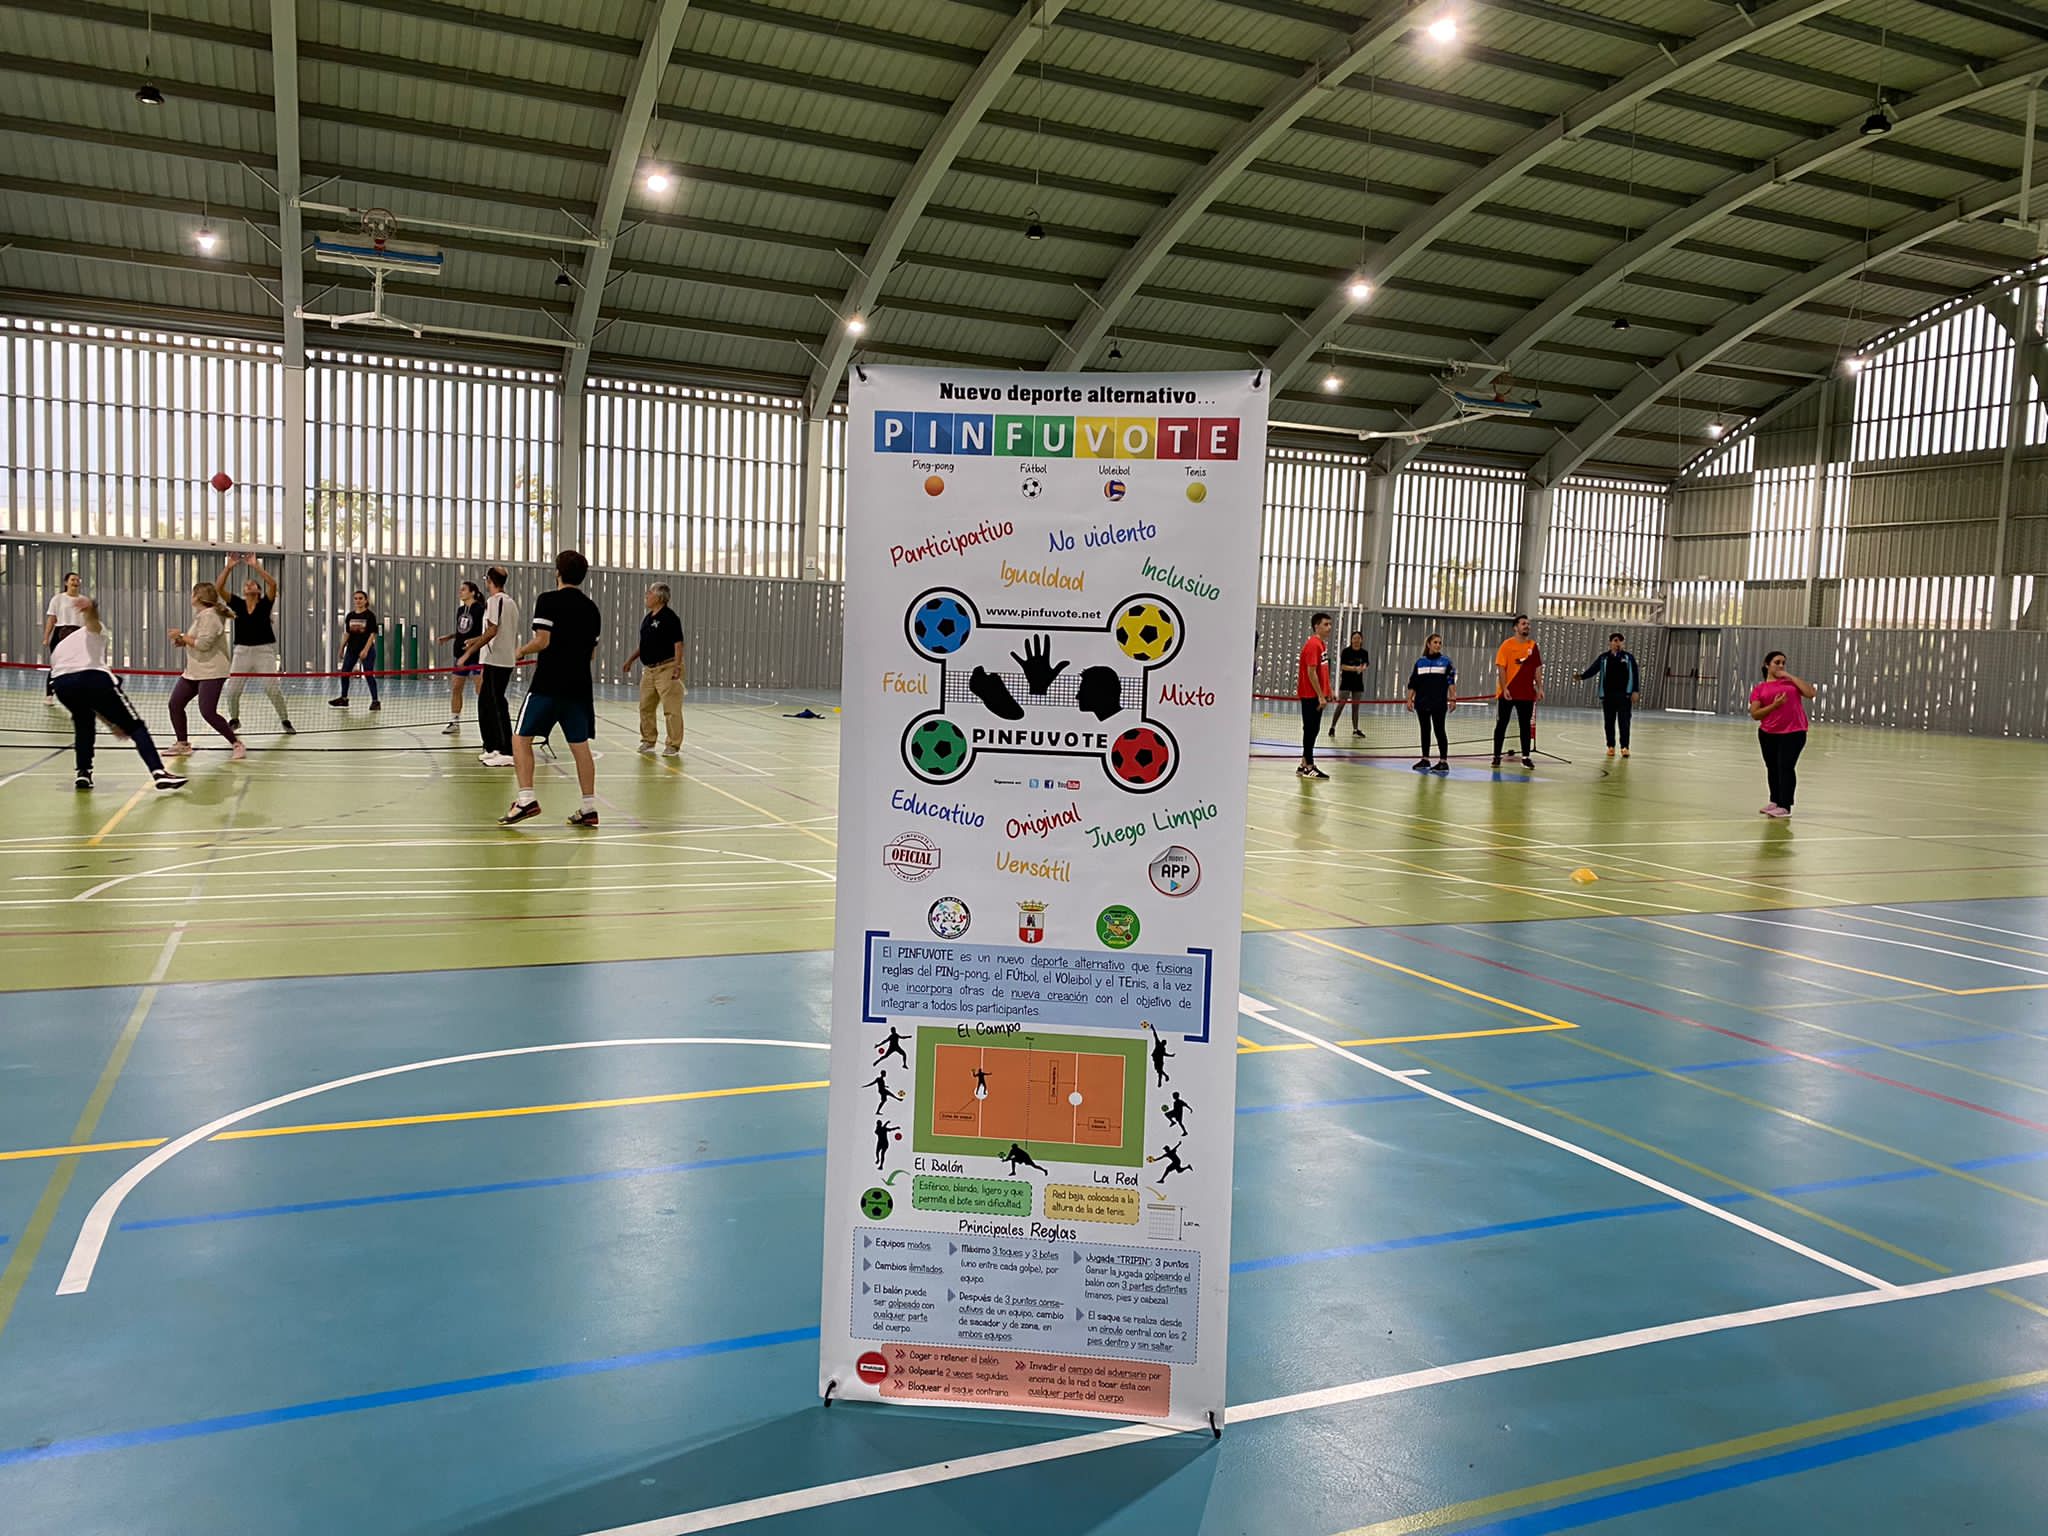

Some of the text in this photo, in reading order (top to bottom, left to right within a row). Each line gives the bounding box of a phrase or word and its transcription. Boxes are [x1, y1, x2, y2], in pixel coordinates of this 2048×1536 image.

[939, 382, 1002, 401] Nuevo
[1007, 384, 1083, 406] deporte
[884, 418, 1227, 455] PINFUVOTE
[912, 459, 954, 473] Ping-pong
[1020, 462, 1048, 474] Fútbol
[1098, 464, 1131, 477] Voleibol
[1184, 466, 1208, 478] Tenis
[890, 520, 1014, 567] Participativo
[1049, 520, 1157, 552] No violento
[1000, 560, 1084, 592] Igualdad
[1141, 556, 1220, 600] Inclusivo
[986, 606, 1102, 620] www.pinfuvote.net
[882, 671, 928, 695] Fácil
[1158, 684, 1215, 707] Mixto
[972, 728, 1108, 749] PINFUVOTE
[891, 790, 985, 828] Educativo
[1006, 802, 1082, 840] Original
[1084, 800, 1218, 849] Juego Limpio
[892, 848, 932, 866] OFICIAL
[996, 850, 1071, 882] Versátil
[1161, 864, 1190, 879] APP
[882, 946, 1192, 974] El PINFUVOTE es un nuevo deporte alternativo que fusiona
[882, 964, 914, 977] reglas
[918, 964, 932, 977] del
[994, 970, 1002, 980] el
[1006, 968, 1040, 983] FÚtbol,
[1043, 972, 1052, 984] el
[1055, 972, 1092, 986] VOleibol
[1095, 976, 1102, 988] y
[1106, 975, 1114, 987] el
[1118, 976, 1150, 990] TEnis,
[1152, 980, 1160, 990] a
[1162, 978, 1172, 990] la
[1174, 982, 1192, 992] vez
[882, 982, 1192, 1009] que incorpora otras de nueva creación con el objetivo de
[880, 998, 920, 1012] integrar
[932, 1000, 957, 1012] todos
[960, 1000, 974, 1012] los
[957, 1022, 1021, 1038] El Campo
[914, 1158, 964, 1174] El Balón
[1093, 1170, 1138, 1186] La Red
[982, 1183, 1002, 1196] ligero
[1010, 1188, 1024, 1197] que
[1052, 1188, 1066, 1200] Red
[1127, 1194, 1134, 1204] la
[948, 1194, 956, 1205] el
[956, 1196, 973, 1206] bote
[1074, 1204, 1085, 1214] de
[1086, 1204, 1094, 1214] la
[1094, 1206, 1105, 1216] de
[958, 1220, 1077, 1243] Principales Reglas
[875, 1237, 906, 1248] Equipos
[874, 1260, 908, 1271] Cambios
[1162, 1259, 1189, 1269] puntos
[874, 1284, 928, 1297] El balón puede
[920, 1302, 935, 1310] con
[1088, 1310, 1095, 1319] El
[872, 1322, 884, 1330] del
[1181, 1331, 1188, 1341] 2
